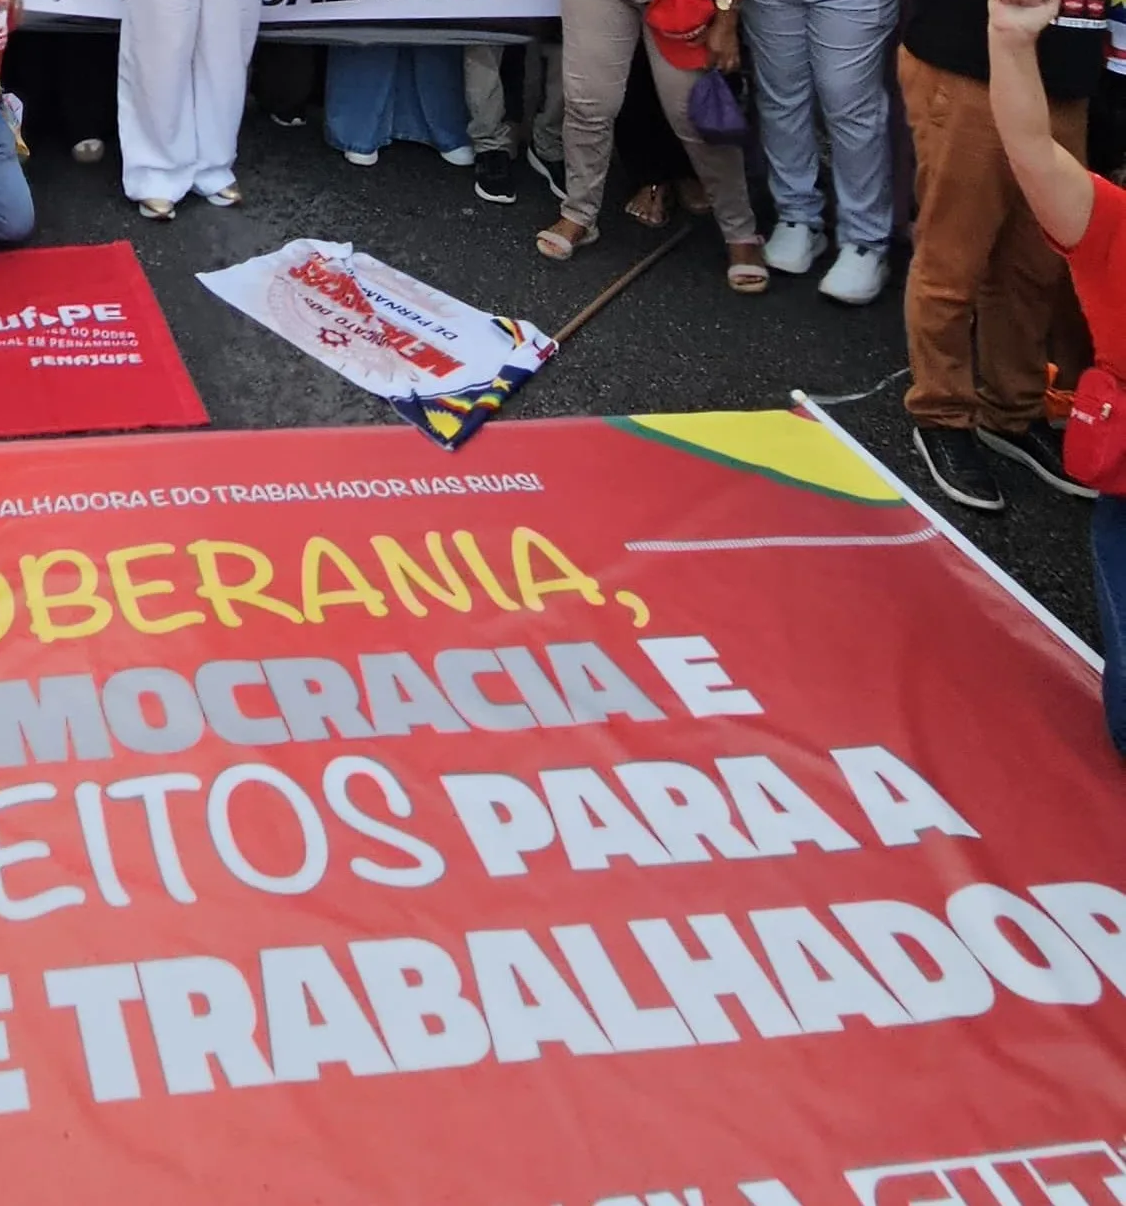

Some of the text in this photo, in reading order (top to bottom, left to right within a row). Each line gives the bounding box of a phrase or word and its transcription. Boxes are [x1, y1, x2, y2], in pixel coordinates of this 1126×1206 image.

[29, 352, 143, 367] FENAJUFE
[149, 487, 169, 507] E
[171, 486, 210, 506] DO
[212, 477, 414, 505] TRABALHADOR
[408, 475, 467, 496] NAS
[463, 472, 546, 495] RUAS!
[637, 634, 765, 721] E
[447, 757, 877, 879] PARA
[829, 745, 982, 844] A
